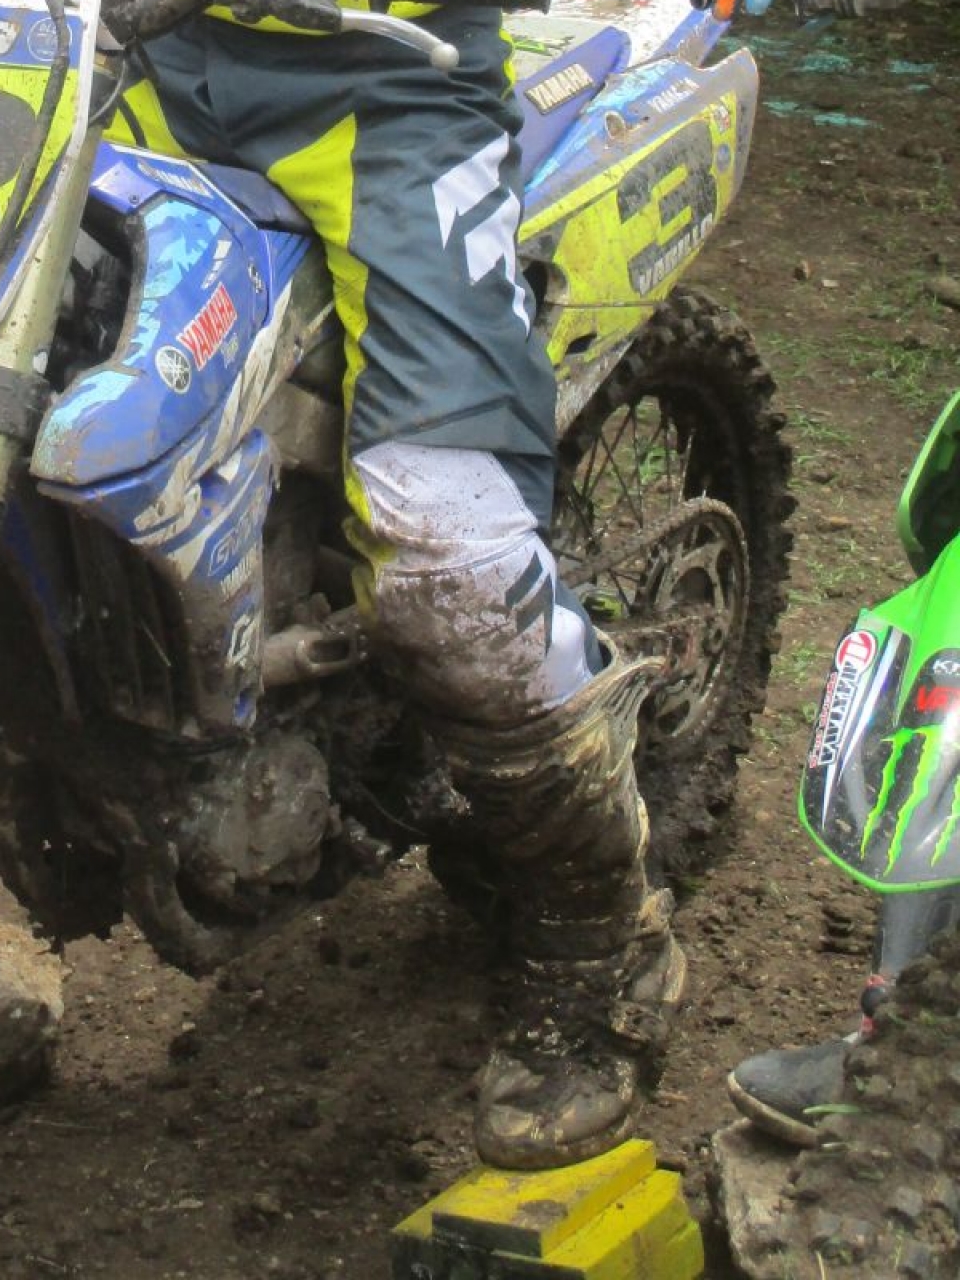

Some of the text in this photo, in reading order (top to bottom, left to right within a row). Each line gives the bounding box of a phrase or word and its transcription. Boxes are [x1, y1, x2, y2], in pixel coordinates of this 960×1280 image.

[527, 63, 593, 114] YAMAHA
[616, 119, 717, 296] 3
[176, 281, 238, 372] YAMAHA
